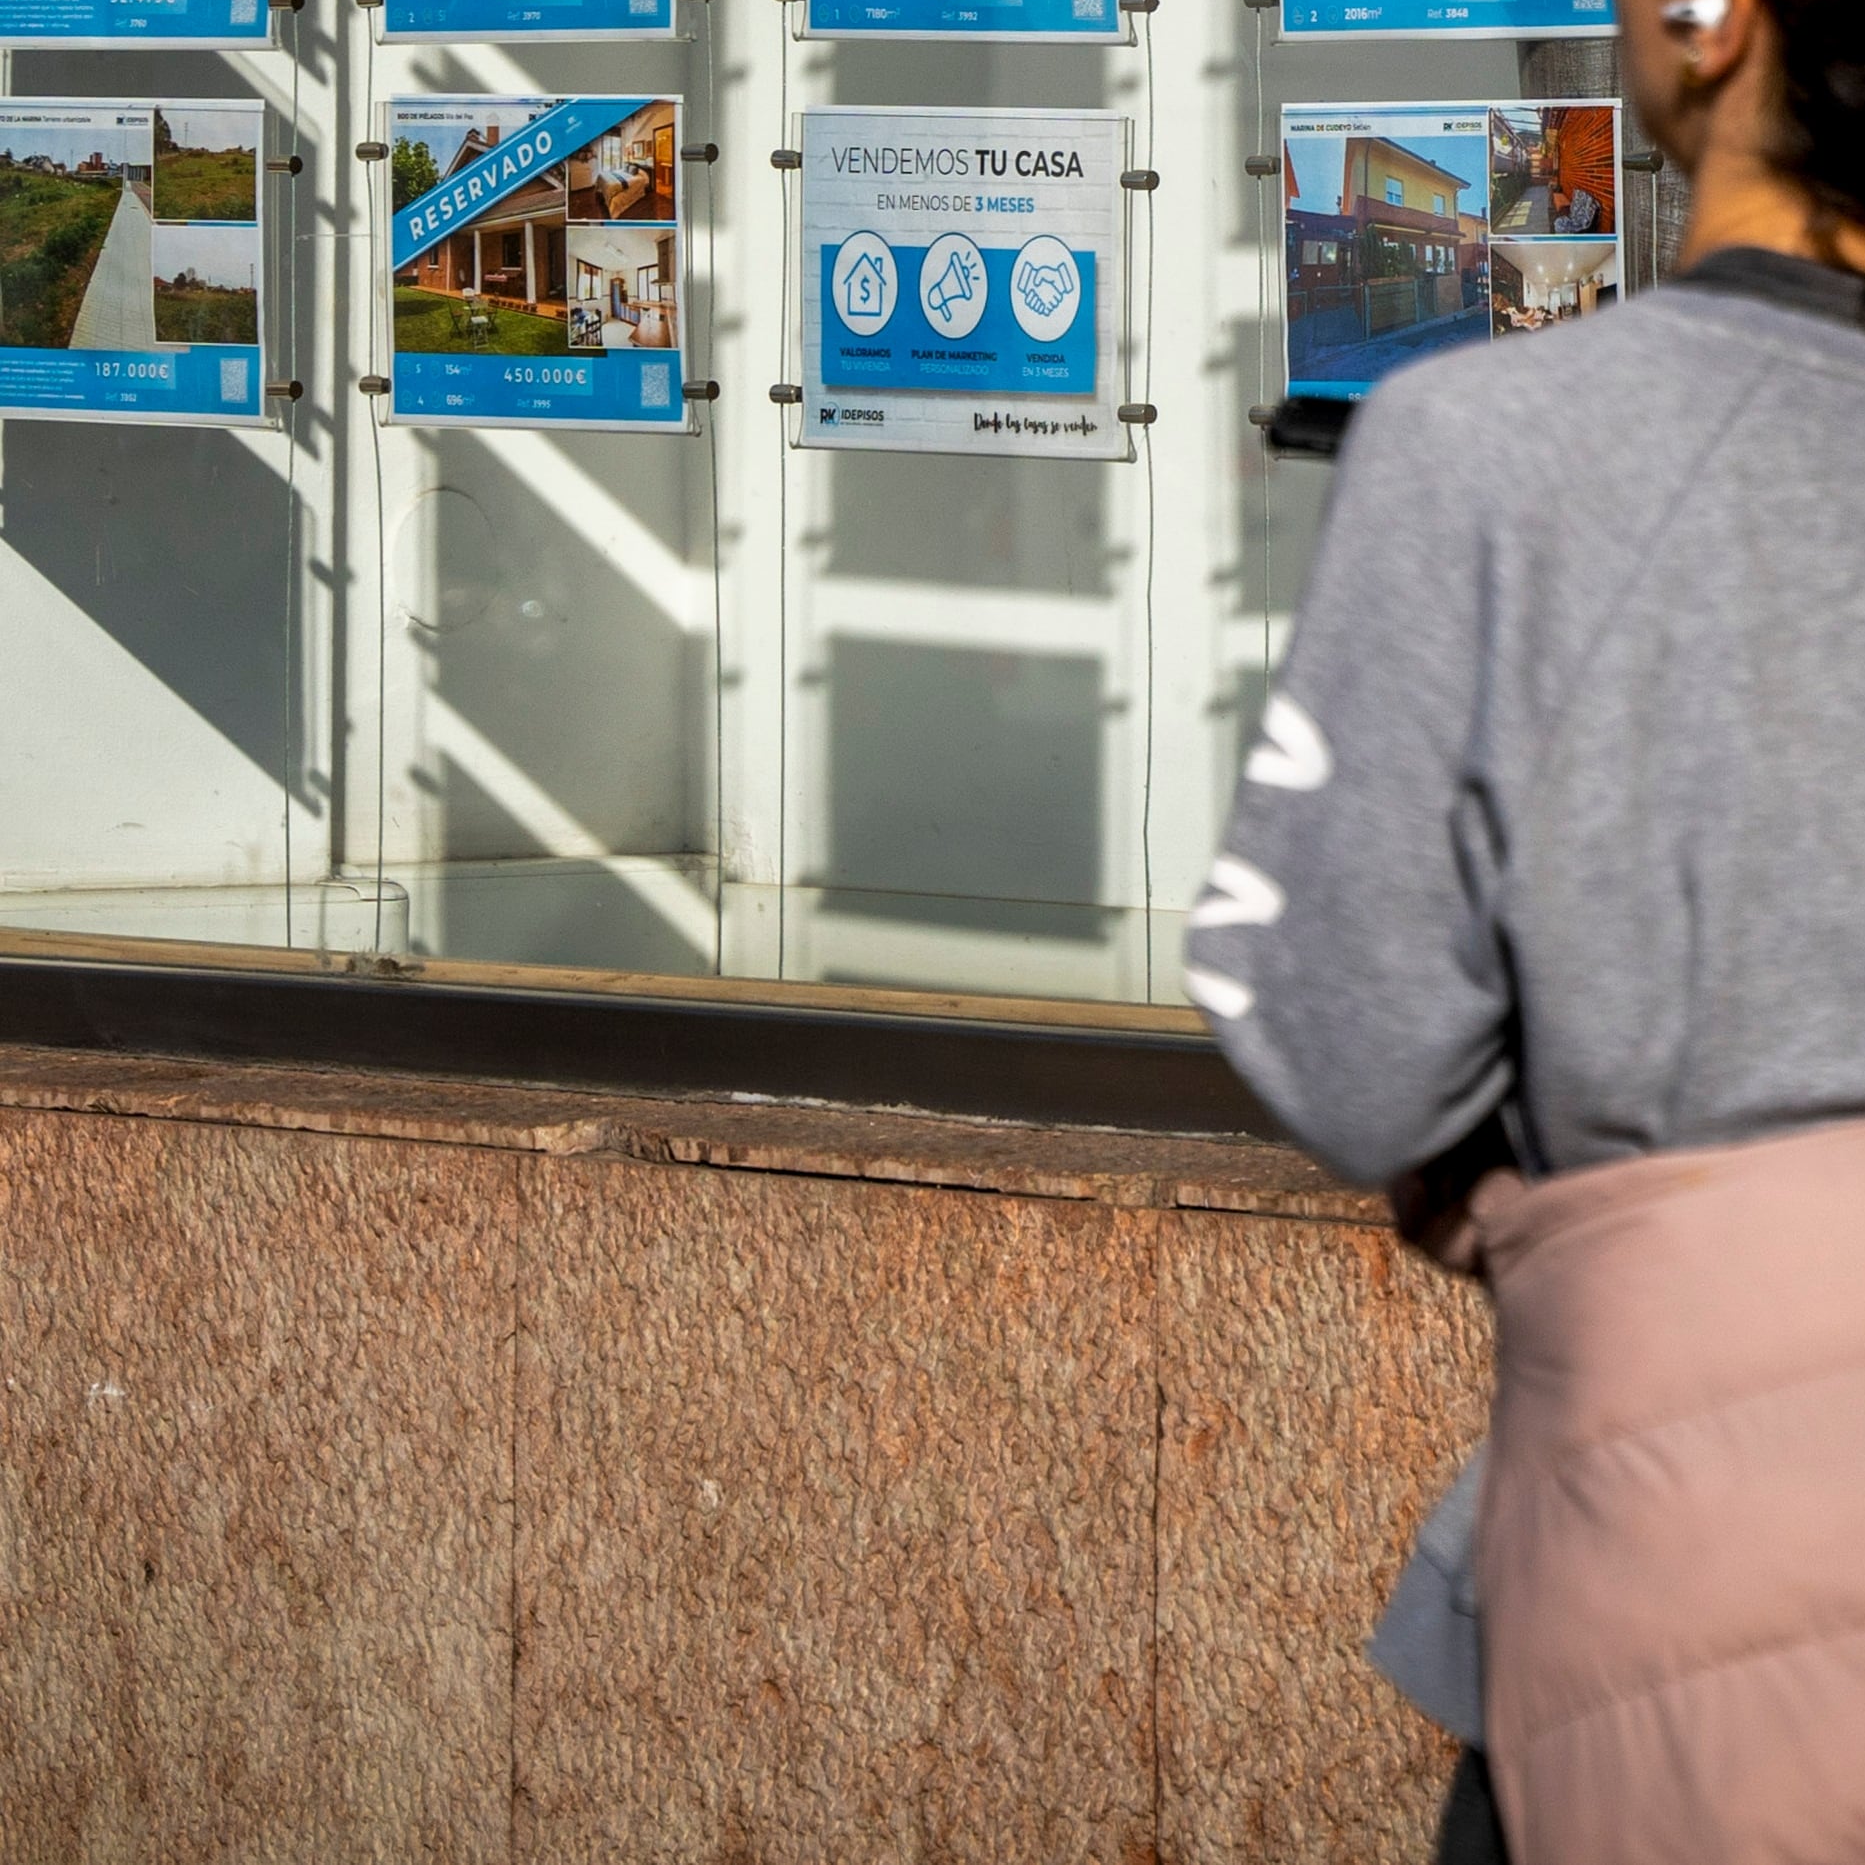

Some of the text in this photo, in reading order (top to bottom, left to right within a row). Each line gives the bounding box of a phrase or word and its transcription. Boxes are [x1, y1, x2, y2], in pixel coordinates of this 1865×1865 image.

[832, 146, 1085, 179] VENDEMOS TU CASA
[409, 130, 553, 242] RESERVADO
[877, 193, 1035, 213] EN MENOS DE 3 MESES
[839, 347, 891, 359] VALORAMOS
[911, 349, 933, 360] PLAN
[948, 350, 998, 362] MARKETING
[1026, 352, 1065, 364] VENDIDA
[95, 361, 169, 379] 187.000€
[503, 367, 587, 385] 450.000€
[820, 407, 885, 425] RK IDEPISOS
